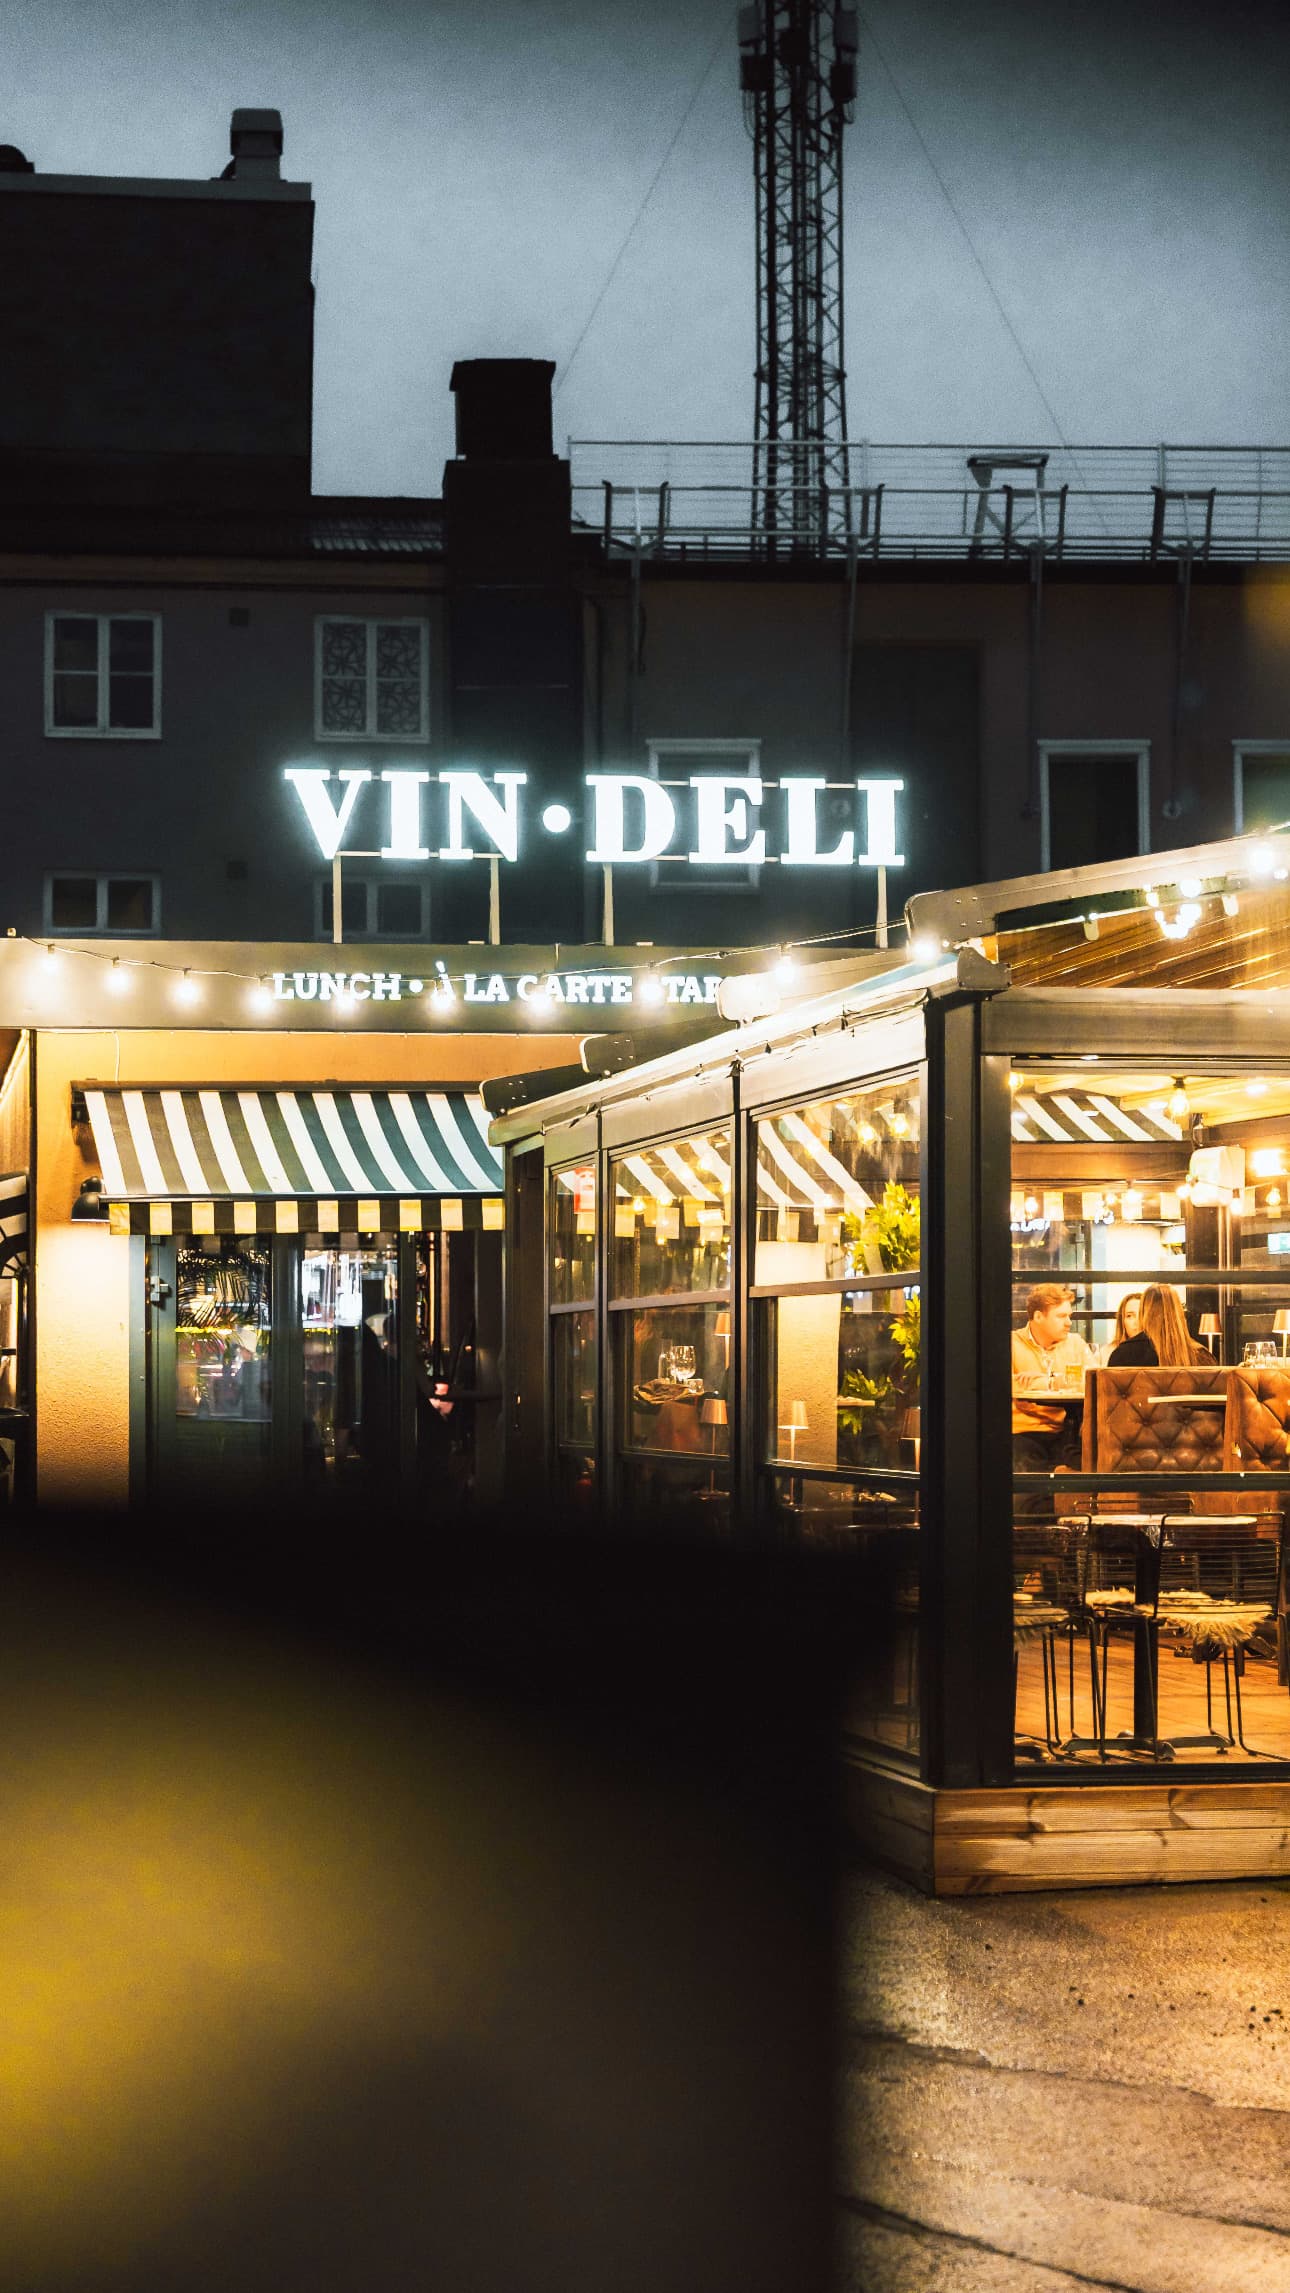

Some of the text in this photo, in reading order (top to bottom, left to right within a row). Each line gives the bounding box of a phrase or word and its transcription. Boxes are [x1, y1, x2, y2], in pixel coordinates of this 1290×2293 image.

[284, 768, 906, 866] VIN DELI
[272, 972, 401, 1000] LUNCH
[463, 973, 510, 1001] LA
[516, 975, 632, 1003] CARTE
